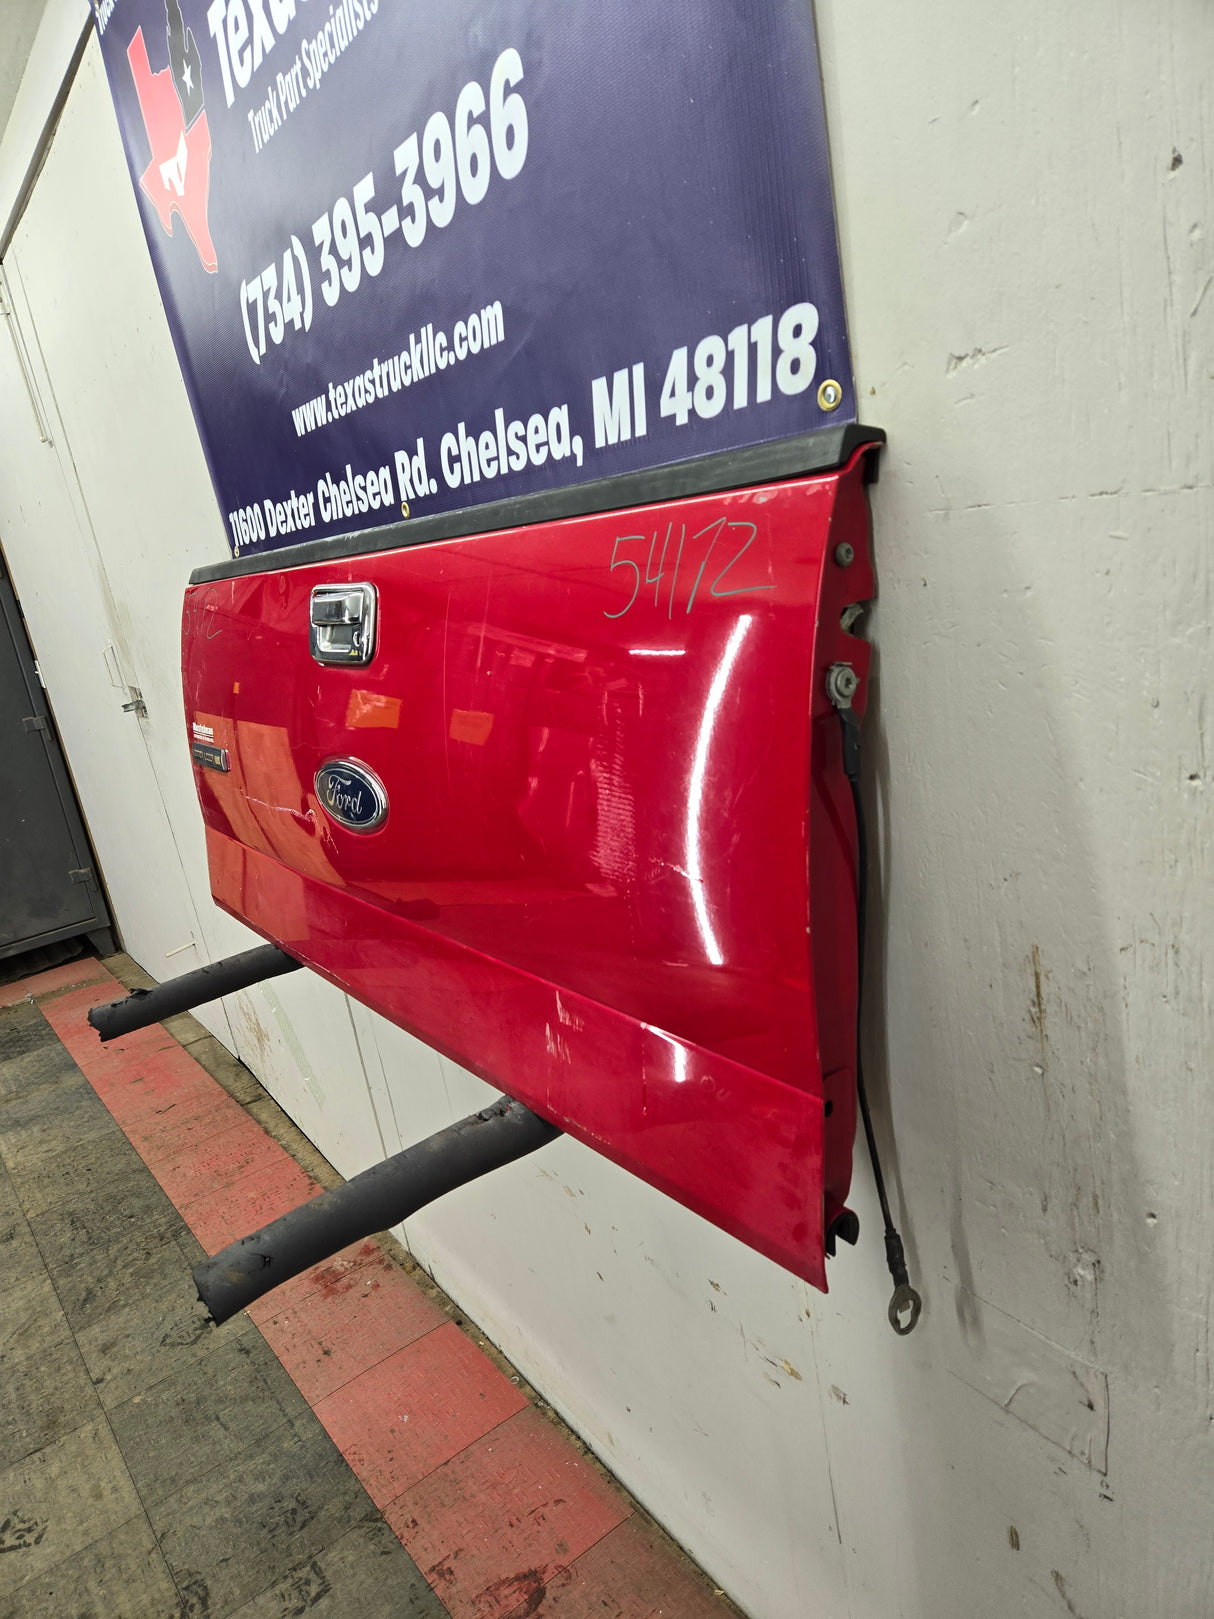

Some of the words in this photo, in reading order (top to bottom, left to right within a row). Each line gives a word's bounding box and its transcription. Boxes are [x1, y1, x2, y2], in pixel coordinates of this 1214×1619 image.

[248, 86, 282, 153] Truck
[276, 55, 307, 121] Part
[240, 235, 313, 366] (734)
[312, 48, 529, 307] 395-3966
[229, 503, 266, 547] 11600
[263, 489, 316, 538] Dexter
[317, 464, 395, 523] Chelsea
[394, 437, 438, 501] Rd.
[440, 404, 584, 489] Chelsea,
[592, 362, 647, 448] MI
[660, 301, 820, 426] 48118
[292, 301, 505, 437] www.texastruckllc.com
[326, 774, 363, 815] Ford
